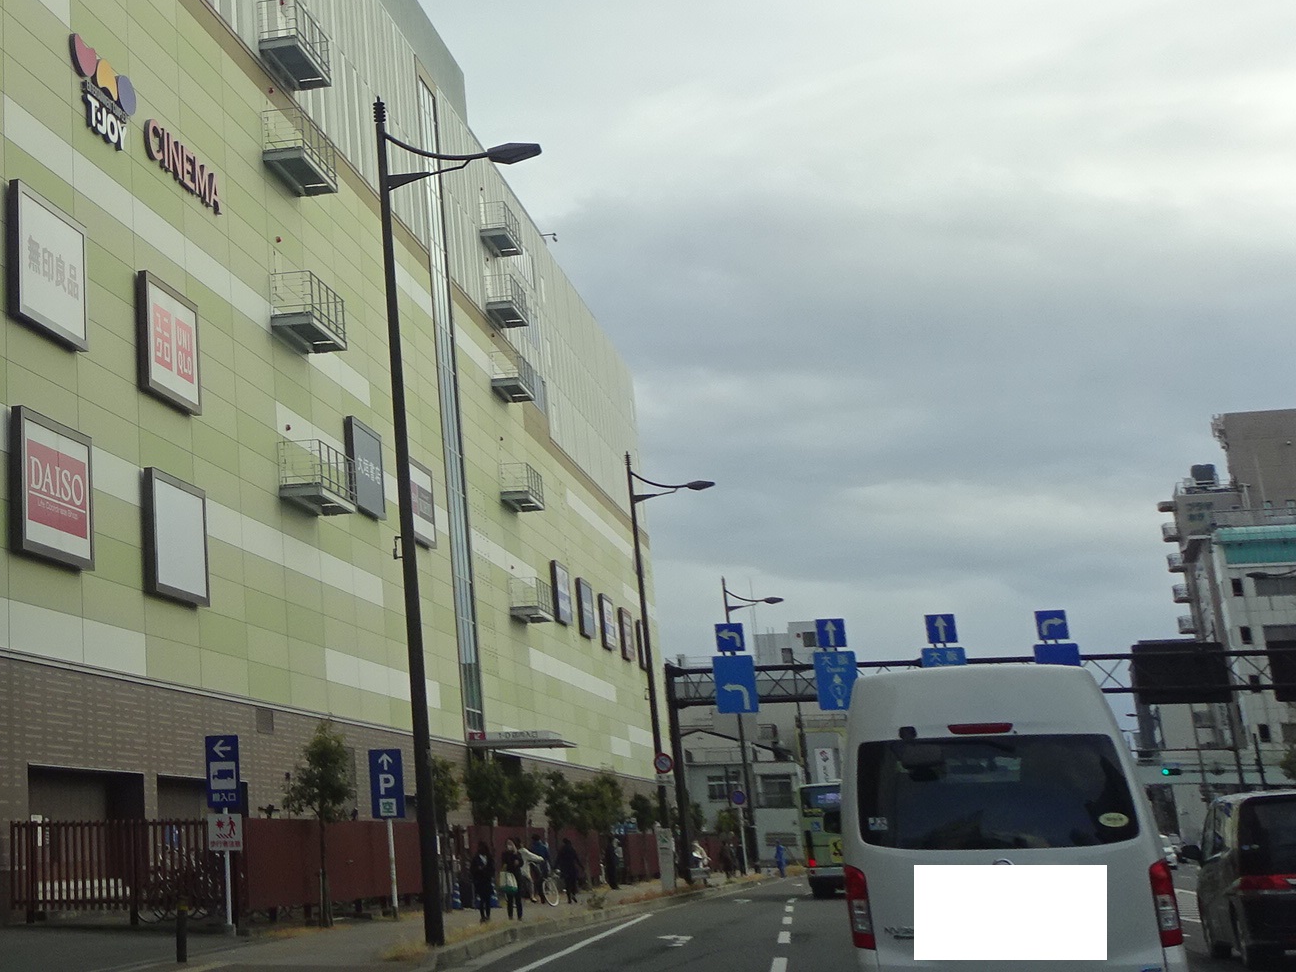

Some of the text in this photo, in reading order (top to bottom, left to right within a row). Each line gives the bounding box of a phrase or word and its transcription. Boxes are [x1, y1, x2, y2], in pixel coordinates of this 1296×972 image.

[144, 118, 222, 215] CINEMA
[27, 234, 79, 301] 無印良品
[156, 312, 170, 338] ユニ
[156, 338, 171, 363] クロ
[177, 326, 190, 351] UNI
[30, 456, 84, 506] DAISO
[379, 773, 395, 795] P
